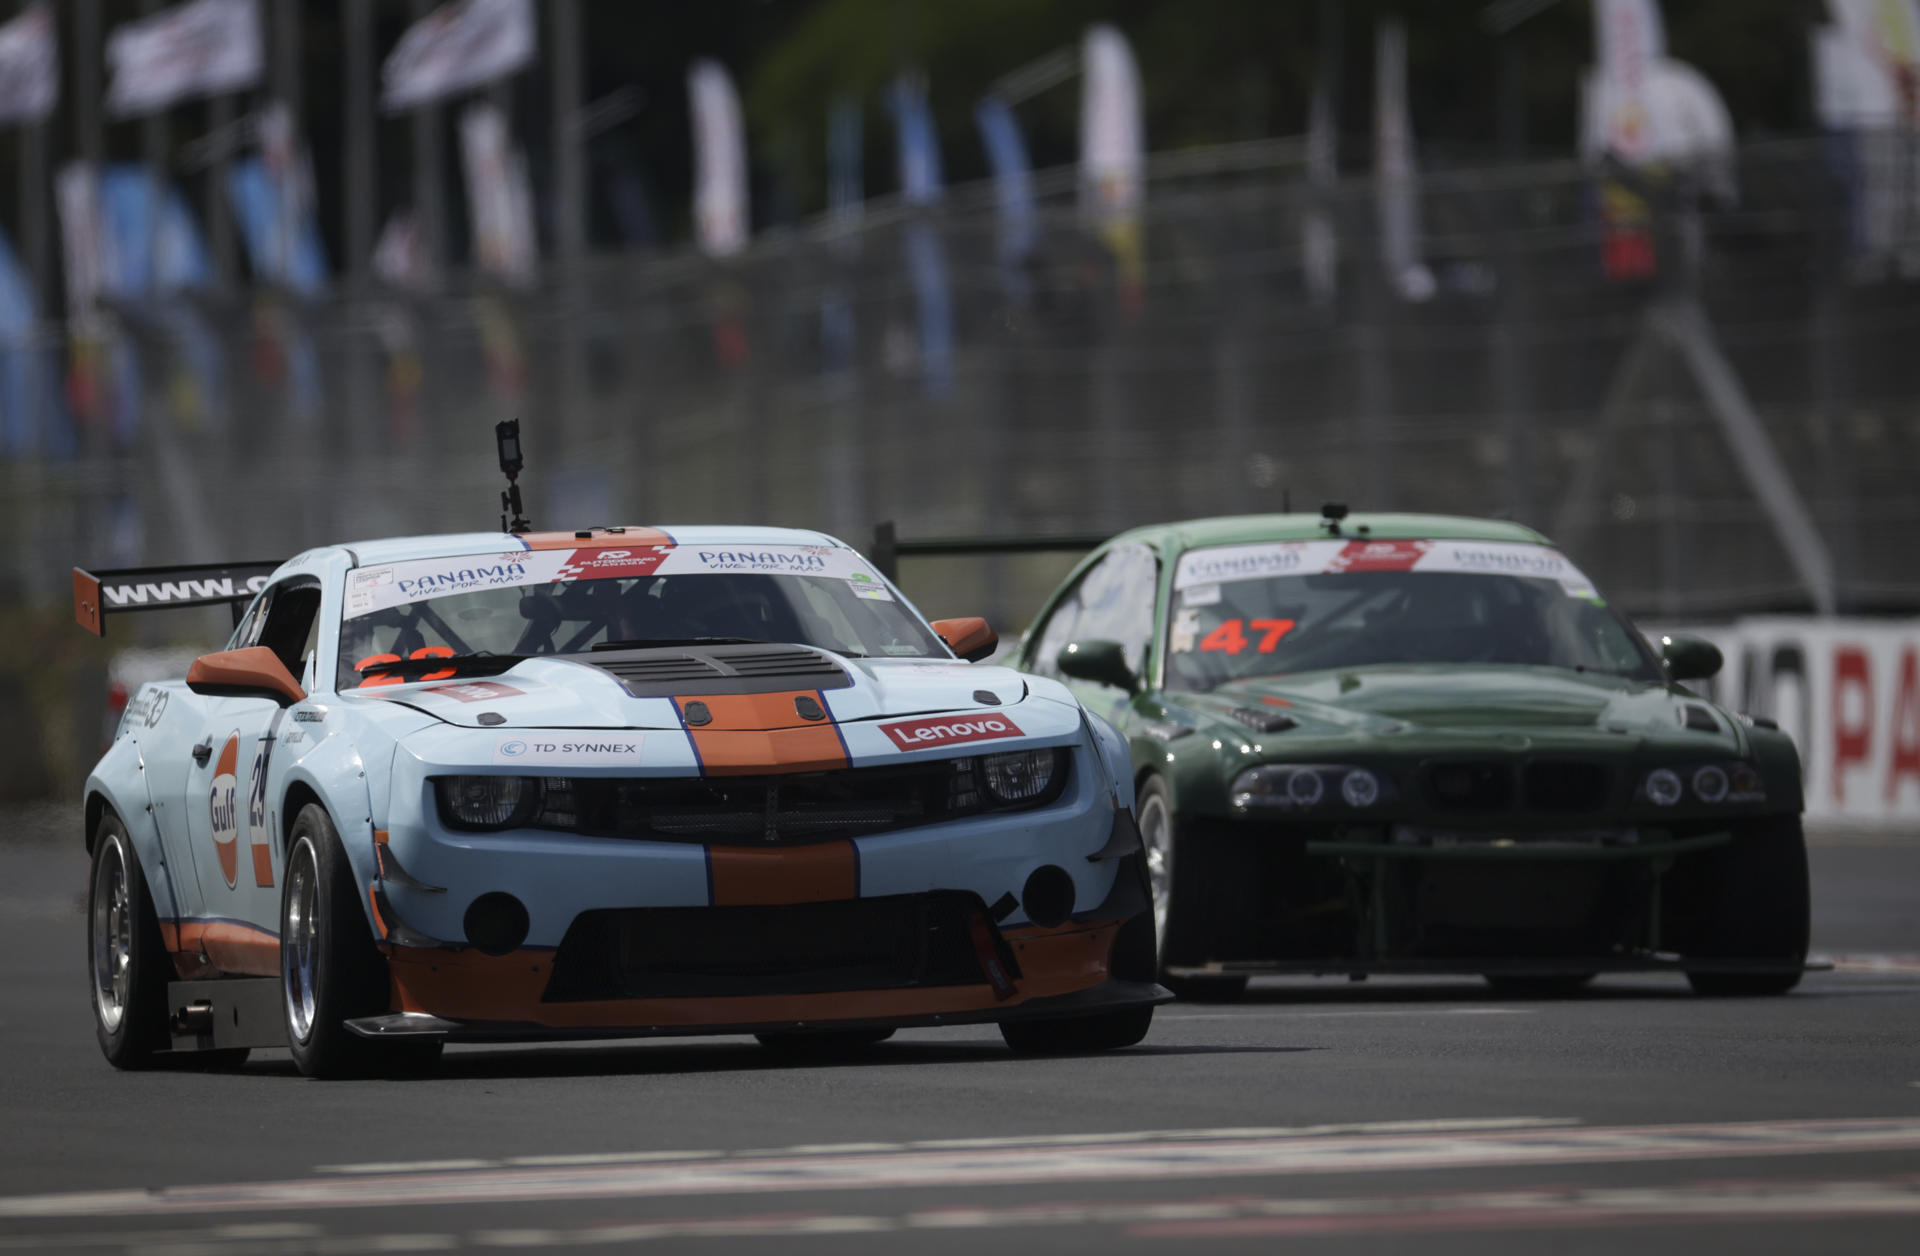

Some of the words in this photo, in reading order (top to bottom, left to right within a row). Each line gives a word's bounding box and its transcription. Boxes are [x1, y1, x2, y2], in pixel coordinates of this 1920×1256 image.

[699, 551, 825, 567] PANAMA
[752, 563, 784, 571] POR
[398, 563, 526, 593] PANAMA
[409, 587, 446, 597] VIVE
[451, 580, 483, 591] POR
[1199, 618, 1296, 655] 47
[894, 719, 1006, 744] Lenovo
[534, 744, 556, 753] TD
[562, 744, 636, 753] SYNNEX
[250, 754, 270, 829] 29
[210, 786, 236, 833] Gulf
